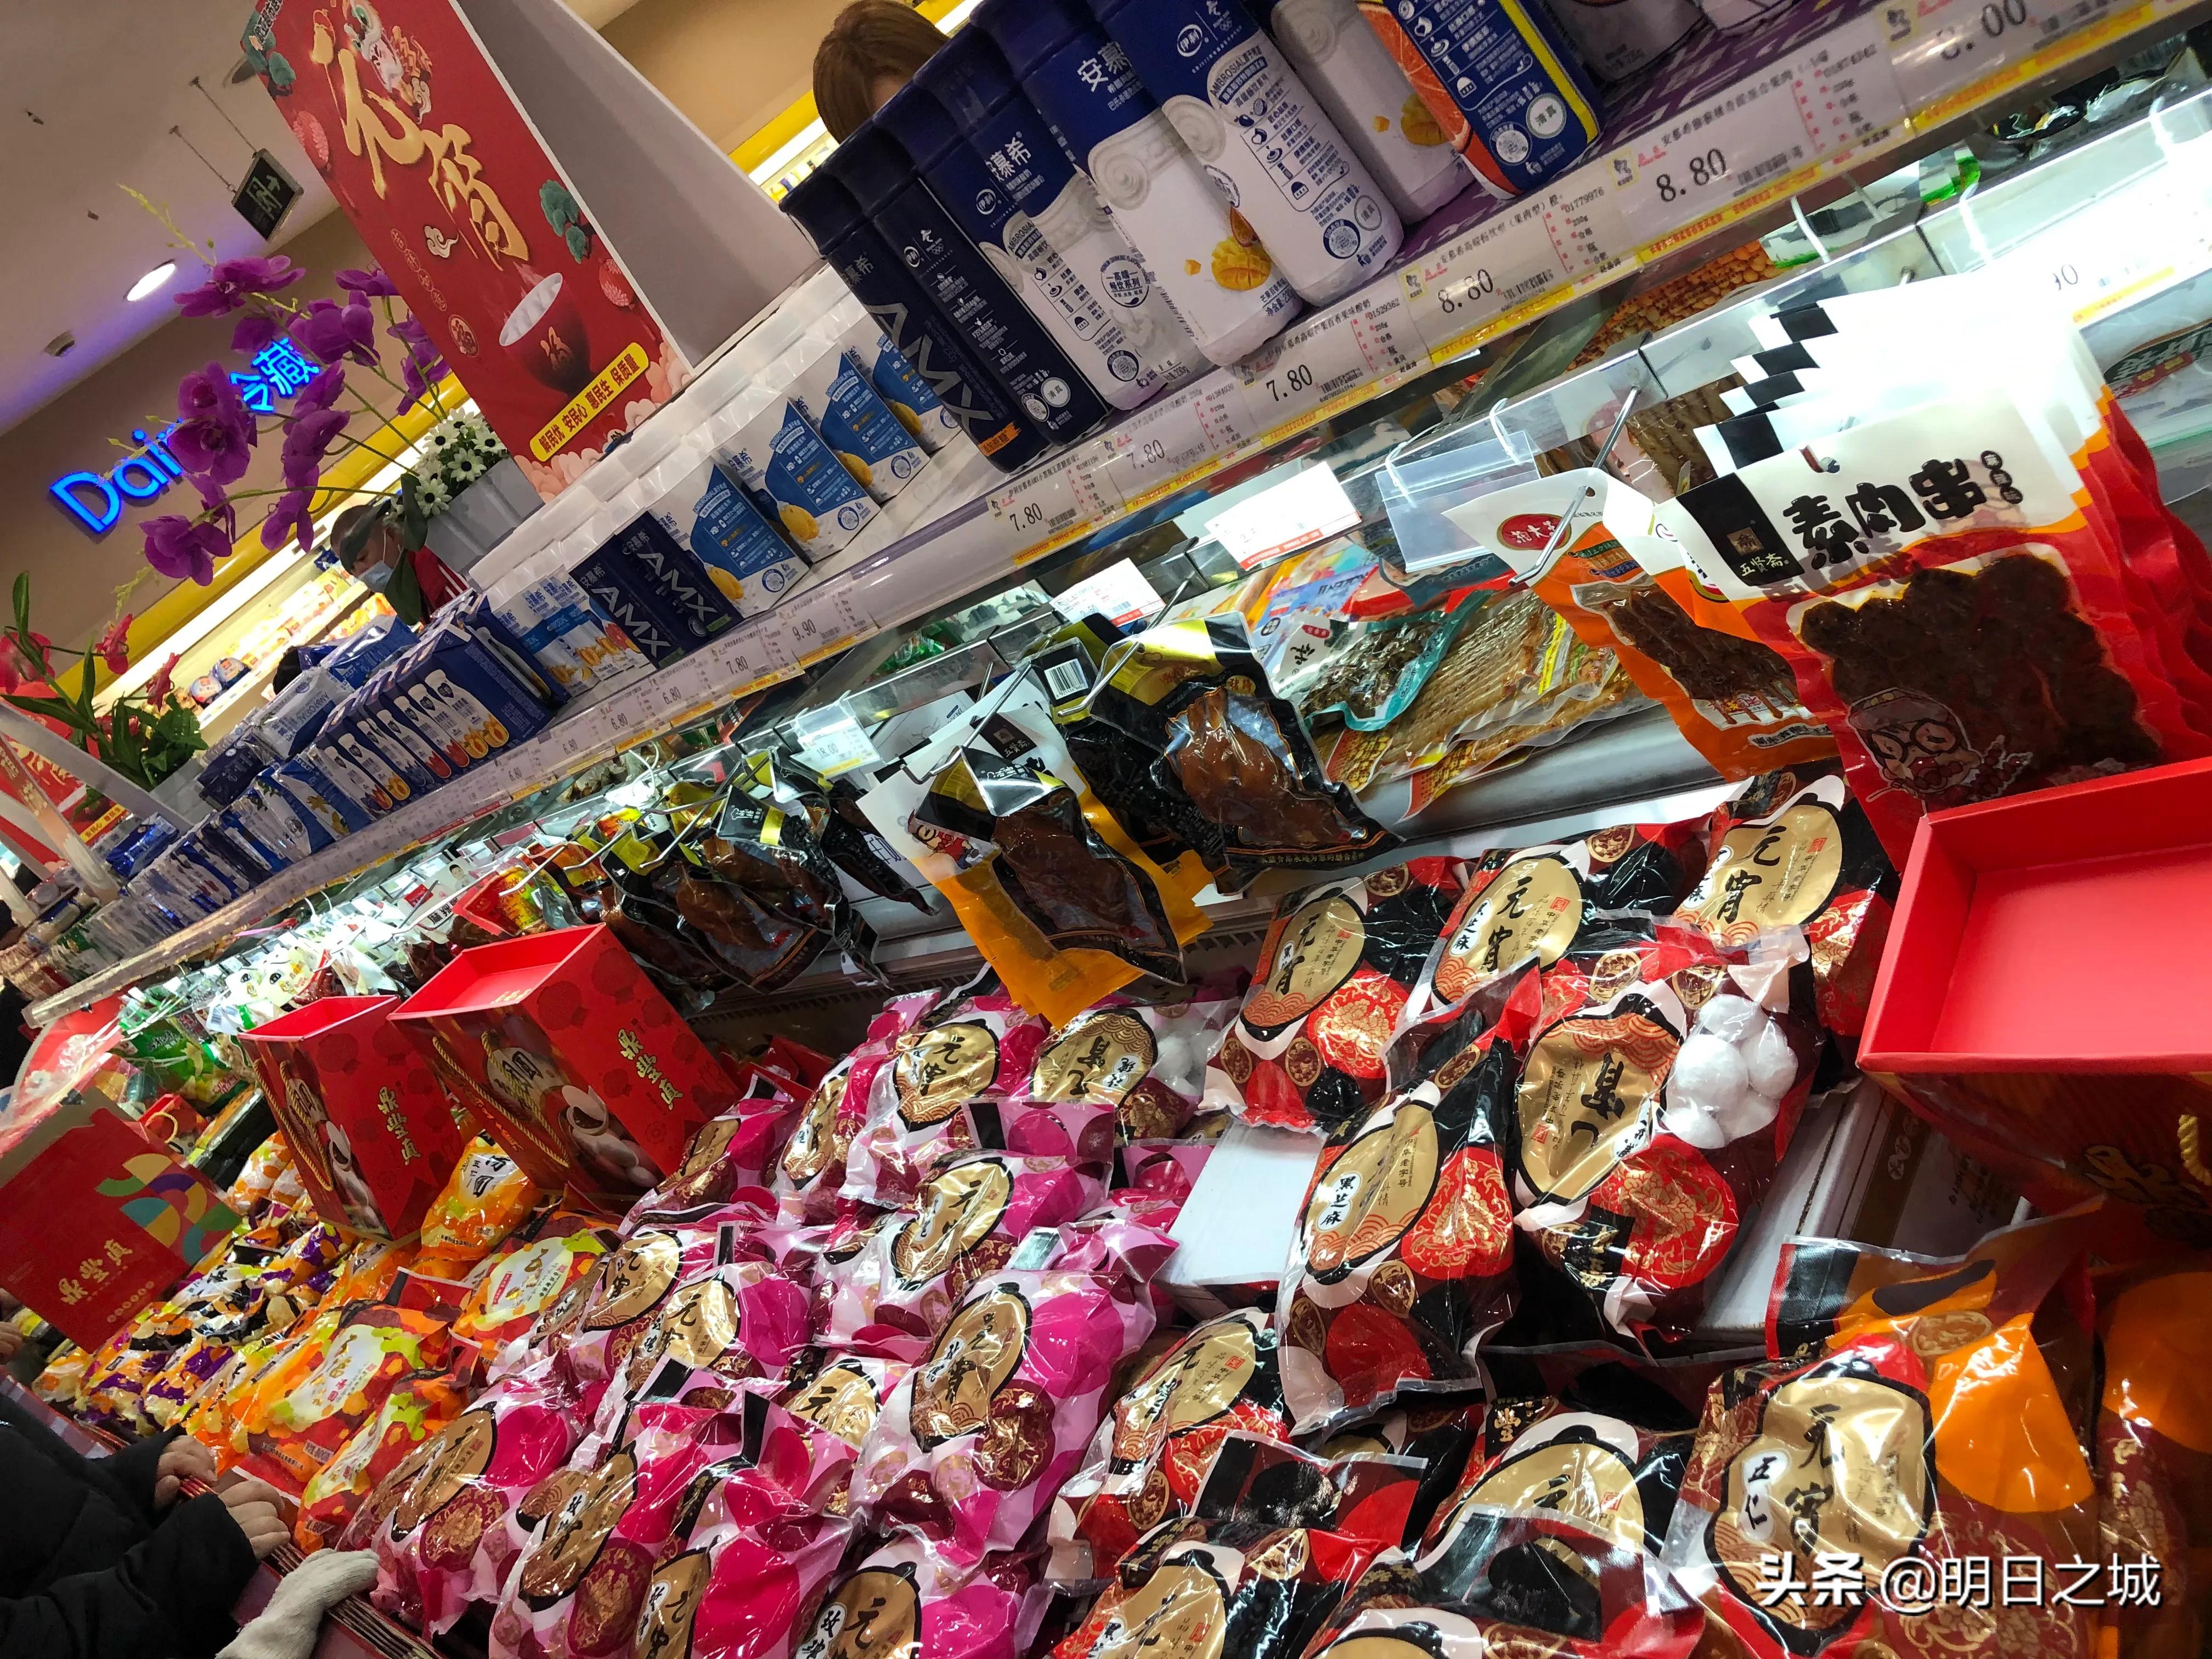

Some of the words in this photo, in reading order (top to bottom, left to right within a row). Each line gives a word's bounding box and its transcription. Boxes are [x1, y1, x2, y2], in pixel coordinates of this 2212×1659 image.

[1653, 146, 1730, 204] 8.80
[1367, 298, 1401, 319] 01529362
[1436, 267, 1496, 314] 8.80
[1265, 363, 1315, 402] 7.80
[538, 425, 566, 454] 解民忧
[561, 403, 589, 432] 安民心
[584, 380, 615, 410] 惠民生
[610, 352, 640, 387] 保质量
[1125, 438, 1166, 472] 7.80
[1008, 501, 1044, 532] 7.80
[1782, 458, 1988, 571] 素肉串
[579, 563, 606, 589] 安慕希
[1739, 552, 1785, 578] 五贤斋
[637, 549, 718, 621] AMX
[592, 586, 670, 658] AMX
[791, 618, 817, 641] 9.90
[726, 654, 749, 675] 7.80
[661, 685, 683, 706] 6.80
[609, 712, 629, 731] 6.80
[561, 737, 579, 755] 6.80
[815, 742, 839, 759] 18.00
[1003, 737, 1031, 758] 五贤斋
[506, 766, 523, 782] 6.80
[1716, 825, 1787, 924] 元宵
[1481, 876, 1533, 975] 元宵
[1276, 913, 1321, 995] 元宵
[1397, 1138, 1413, 1188] 中华老字号
[1320, 1175, 1356, 1226] 黑芝麻
[1746, 1453, 1772, 1531] 五仁
[1784, 1403, 1836, 1556] 元宵
